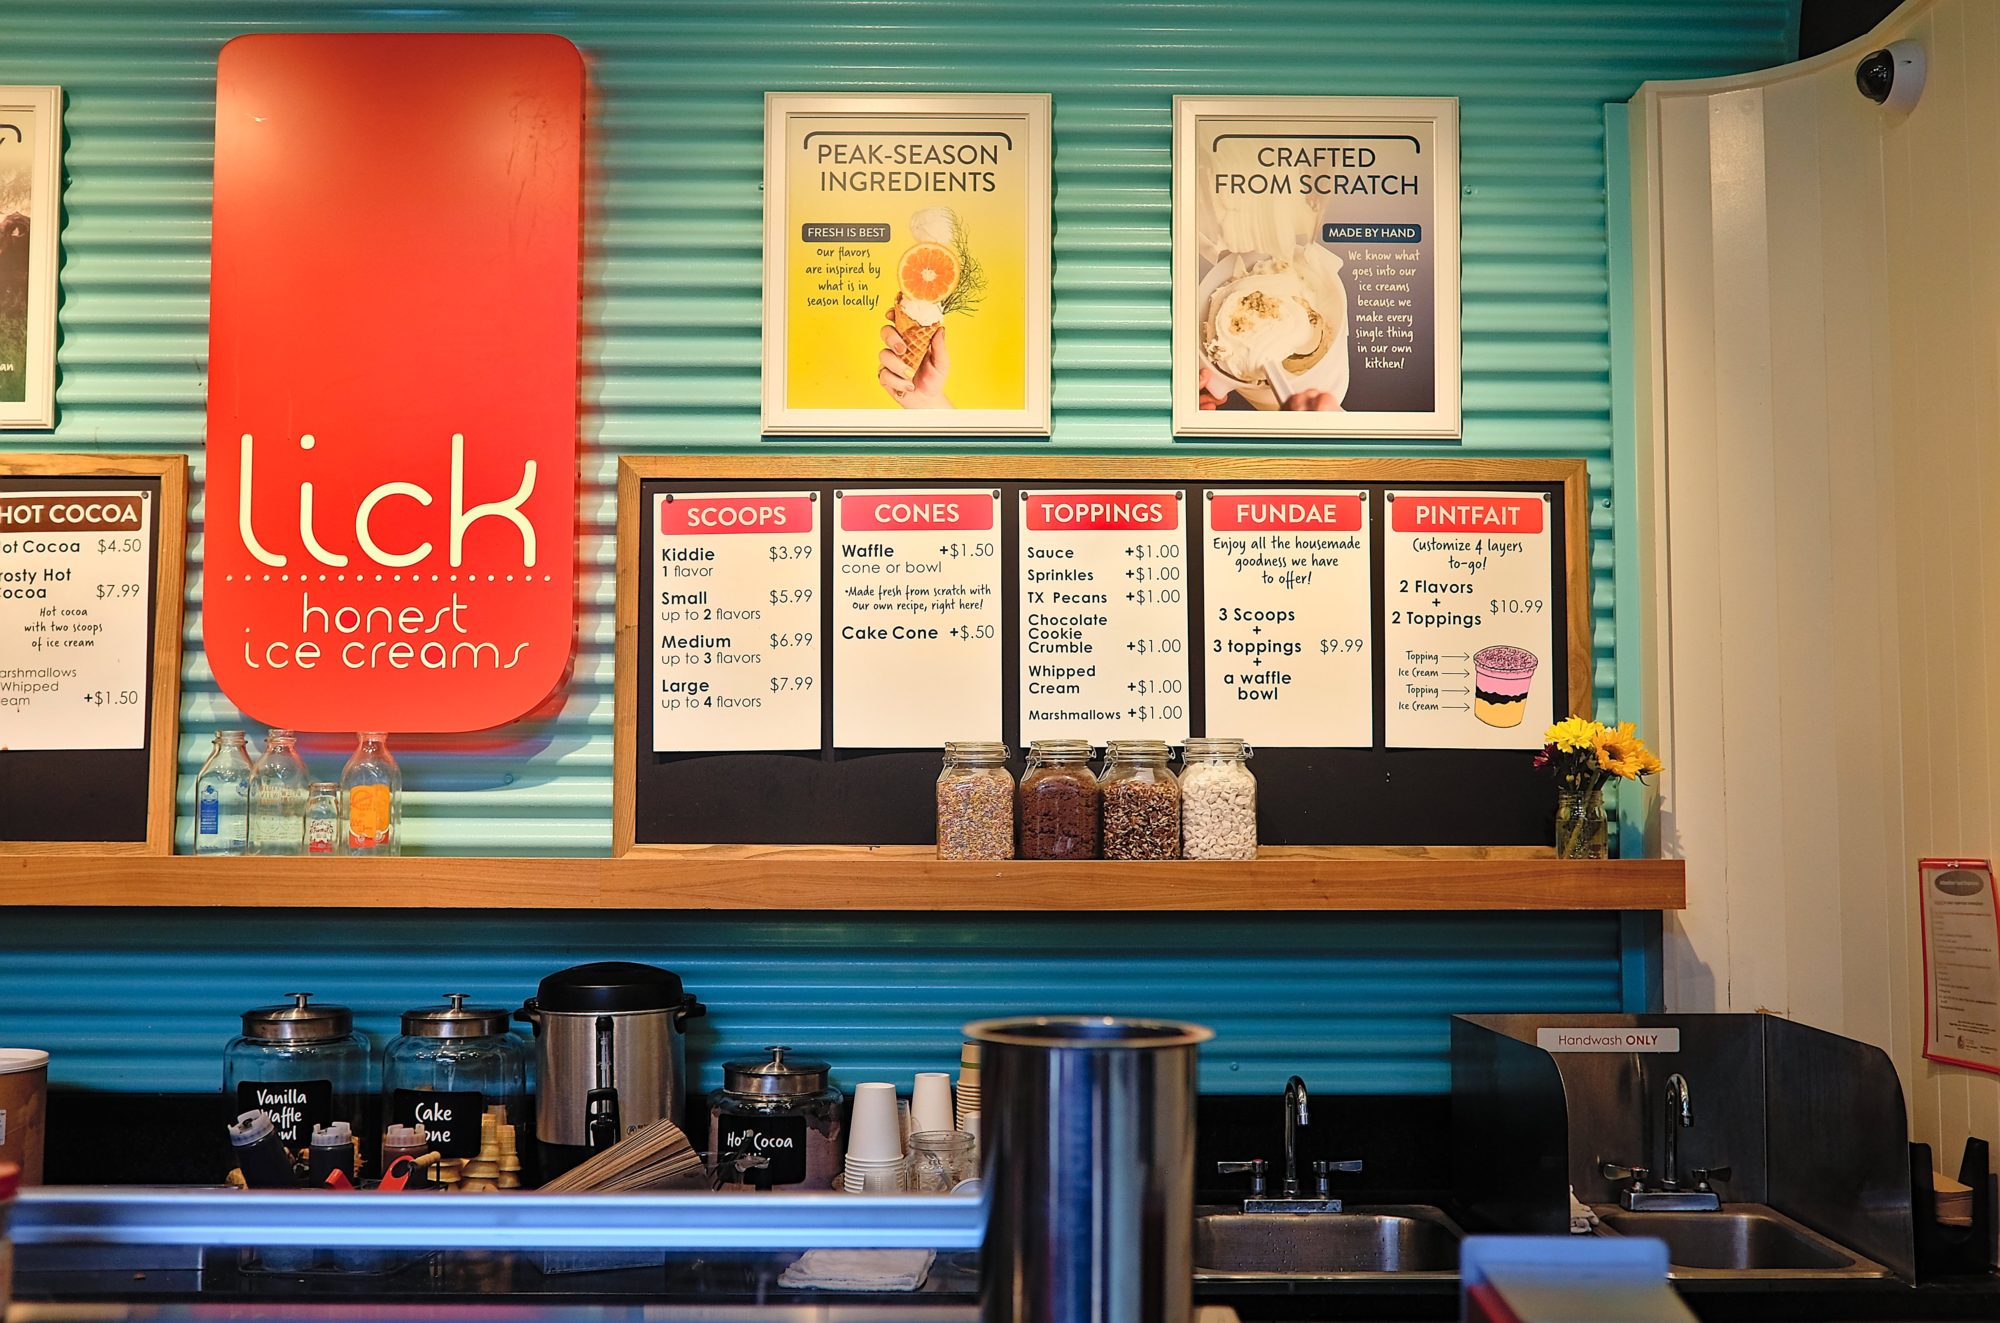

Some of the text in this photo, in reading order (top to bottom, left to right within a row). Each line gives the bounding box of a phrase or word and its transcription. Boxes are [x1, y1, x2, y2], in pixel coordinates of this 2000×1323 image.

[819, 145, 997, 164] PEAK-SEASON
[1258, 148, 1375, 167] CRAFTED
[822, 172, 995, 192] INGREDIENTS
[1216, 174, 1417, 195] FROM SCRATCH
[808, 227, 885, 237] FRESH IS BEST
[1329, 227, 1415, 238] MADE BY HAND
[839, 247, 870, 261] flavors
[1348, 248, 1420, 260] We know what
[806, 263, 880, 278] are inspired by
[1353, 263, 1416, 280] goes into our
[819, 279, 868, 292] what is in
[1359, 280, 1409, 292] ice creams
[808, 295, 879, 310] season locally!
[1358, 294, 1411, 307] because we
[1356, 310, 1412, 327] make every
[1356, 326, 1413, 342] single thing
[1358, 342, 1411, 353] in our own
[1366, 356, 1404, 369] kitchen!
[240, 434, 536, 567] lick
[0, 504, 137, 523] HOT COCOA
[688, 506, 786, 526] SCOOPS
[875, 504, 959, 522] CONES
[1041, 504, 1162, 522] TOPPINGS
[1238, 504, 1336, 523] FUNDAE
[1417, 506, 1520, 525] PINTFAIT
[0, 539, 141, 554] ot Cocoa $4.50
[842, 543, 894, 557] Waffle
[1028, 546, 1073, 558] Sauce
[1214, 535, 1360, 555] Enjoy all the housemade
[1413, 537, 1470, 552] Customize
[1488, 539, 1522, 557] layers
[663, 546, 812, 562] Kiddie $3.99
[842, 560, 941, 574] cone or bowl
[1236, 552, 1338, 572] goodness we have
[1449, 556, 1487, 575] to-go!
[44, 567, 71, 581] Hot
[663, 564, 713, 577] 1 flavor
[1028, 569, 1093, 583] Sprinkles
[1262, 570, 1311, 589] to offer!
[1400, 579, 1473, 593] 2 Flavors
[0, 584, 139, 600] ocoa $7.99
[662, 589, 812, 605] Small $5.99
[879, 585, 901, 600] fresh
[906, 585, 929, 600] from
[934, 584, 966, 596] scratch
[970, 583, 991, 595] with
[1028, 591, 1043, 603] TX
[1054, 591, 1107, 603] Pecans
[40, 605, 87, 617] Hot cocoa
[303, 592, 467, 633] honest
[897, 600, 927, 614] recipe,
[932, 599, 955, 614] right
[960, 598, 983, 609] here!
[1490, 600, 1542, 615] $10.99
[662, 607, 760, 623] up to 2 flavors
[1029, 613, 1107, 625] Chocolate
[1219, 607, 1294, 624] 3 Scoops
[1392, 610, 1481, 628] 2 Toppings
[25, 620, 102, 635] with two scoops
[842, 625, 887, 639] Cake
[893, 625, 938, 639] Cone
[1029, 627, 1082, 639] Cookie
[32, 637, 94, 651] of ice cream
[245, 626, 529, 668] ice creams
[662, 633, 812, 649] Medium $6.99
[1029, 641, 1092, 653] Crumble
[1214, 639, 1363, 655] 3 toppings $9.99
[1406, 650, 1438, 664] Topping
[1029, 665, 1095, 679] Whipped
[1224, 670, 1291, 684] a waffle
[1399, 666, 1438, 677] Ice Cream
[1, 680, 58, 693] Whipped
[663, 677, 812, 695] Large $7.99
[1029, 682, 1079, 694] Cream
[1239, 686, 1277, 700] bowl
[1029, 709, 1120, 720] Marshmallows
[1559, 1034, 1657, 1045] Handwash ONLY
[257, 1089, 306, 1105] Vanilla
[416, 1103, 451, 1122] Cake
[754, 1133, 792, 1150] Cocoa
